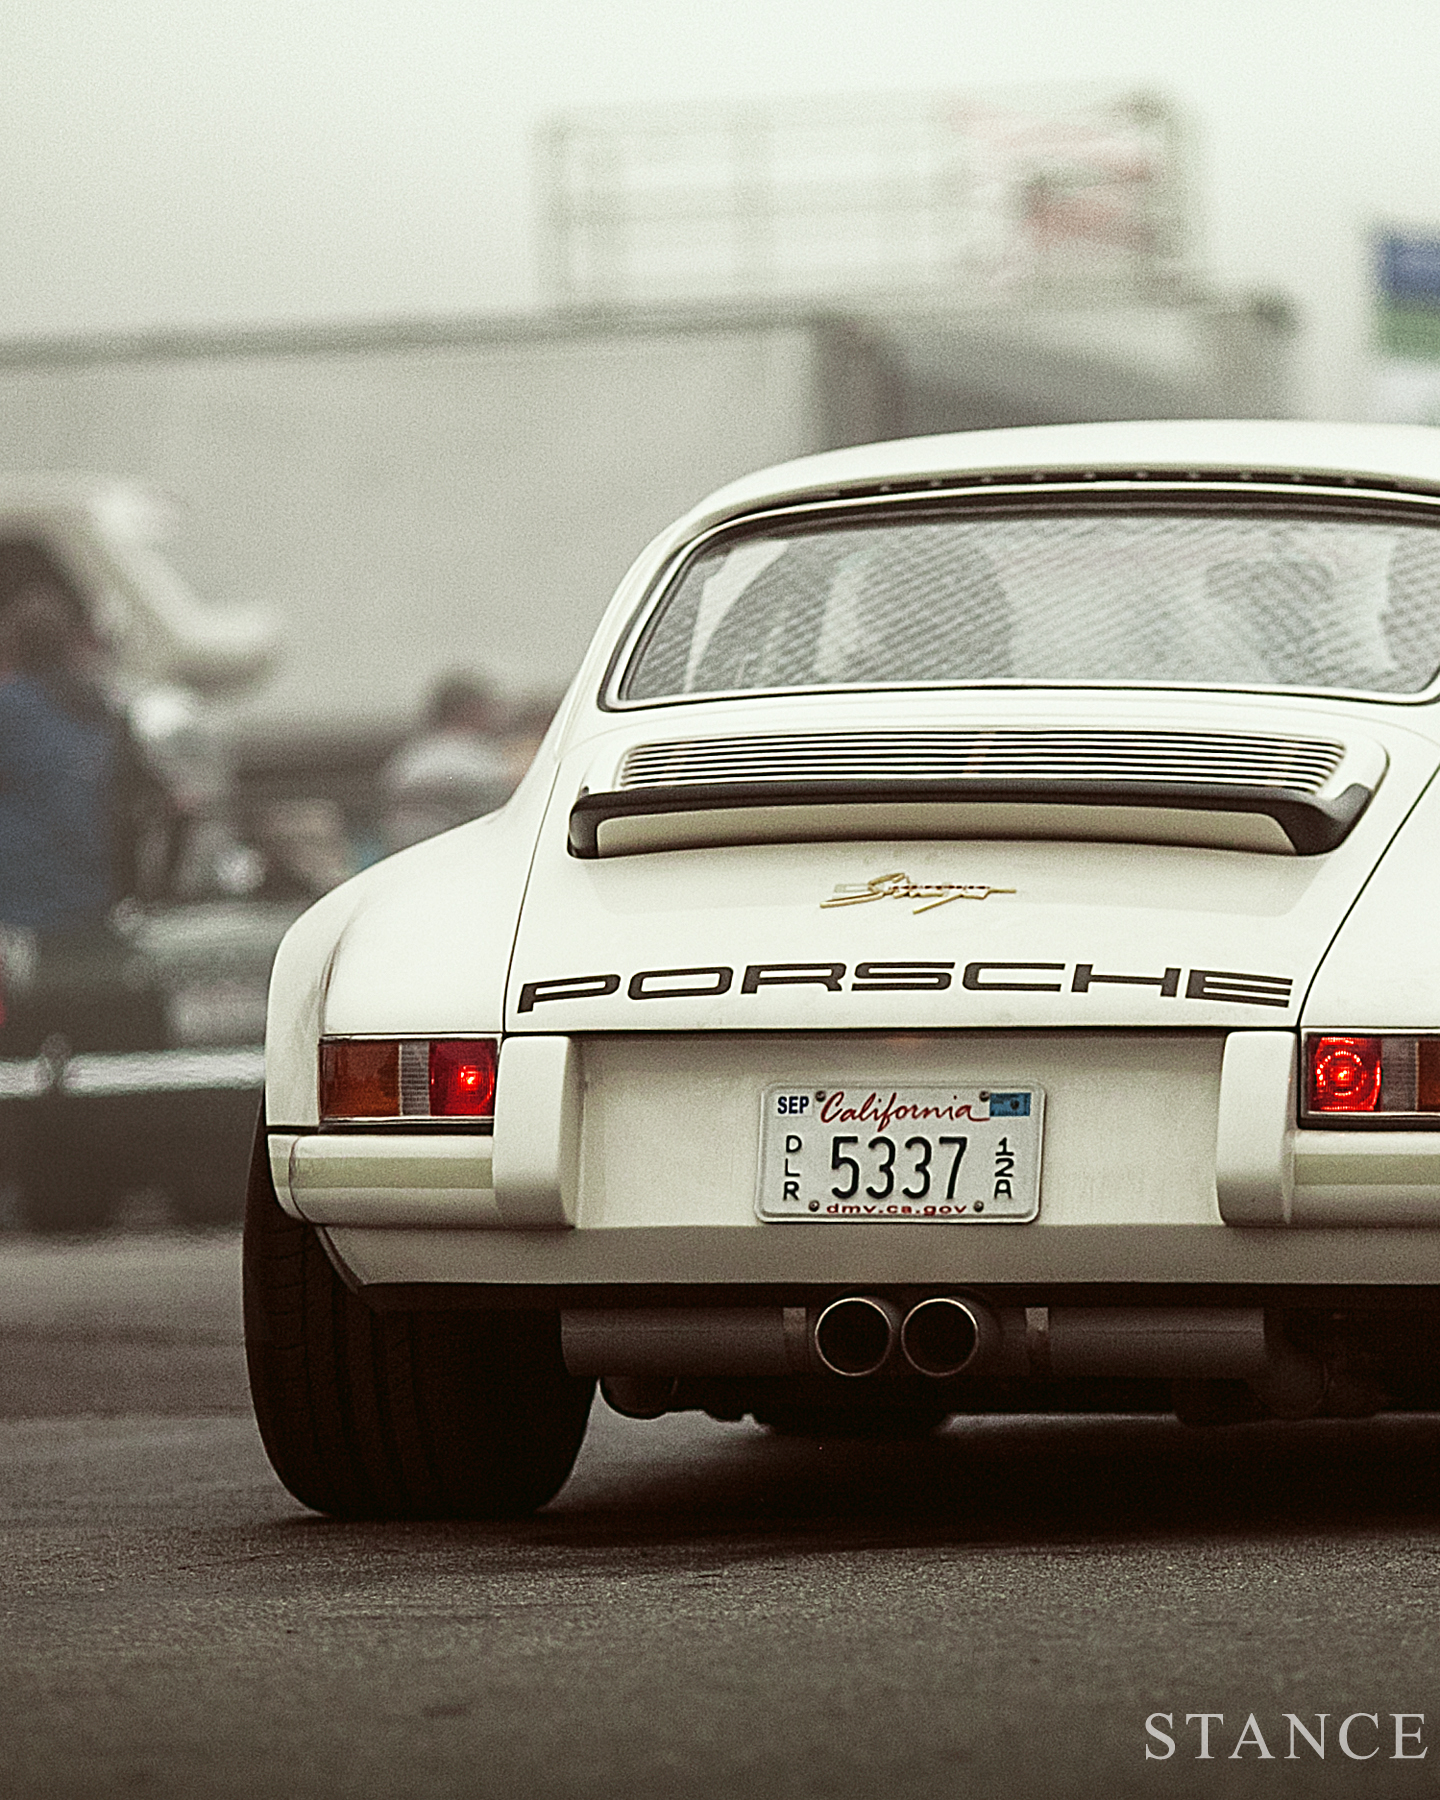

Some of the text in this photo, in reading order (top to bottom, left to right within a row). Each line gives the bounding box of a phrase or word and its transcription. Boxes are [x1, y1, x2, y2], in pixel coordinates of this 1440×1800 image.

[517, 961, 1294, 1014] PORSCHE
[777, 1095, 810, 1115] SEP
[820, 1091, 991, 1132] California
[831, 1135, 968, 1200] 5337
[826, 1203, 968, 1216] dmv.ca.gov
